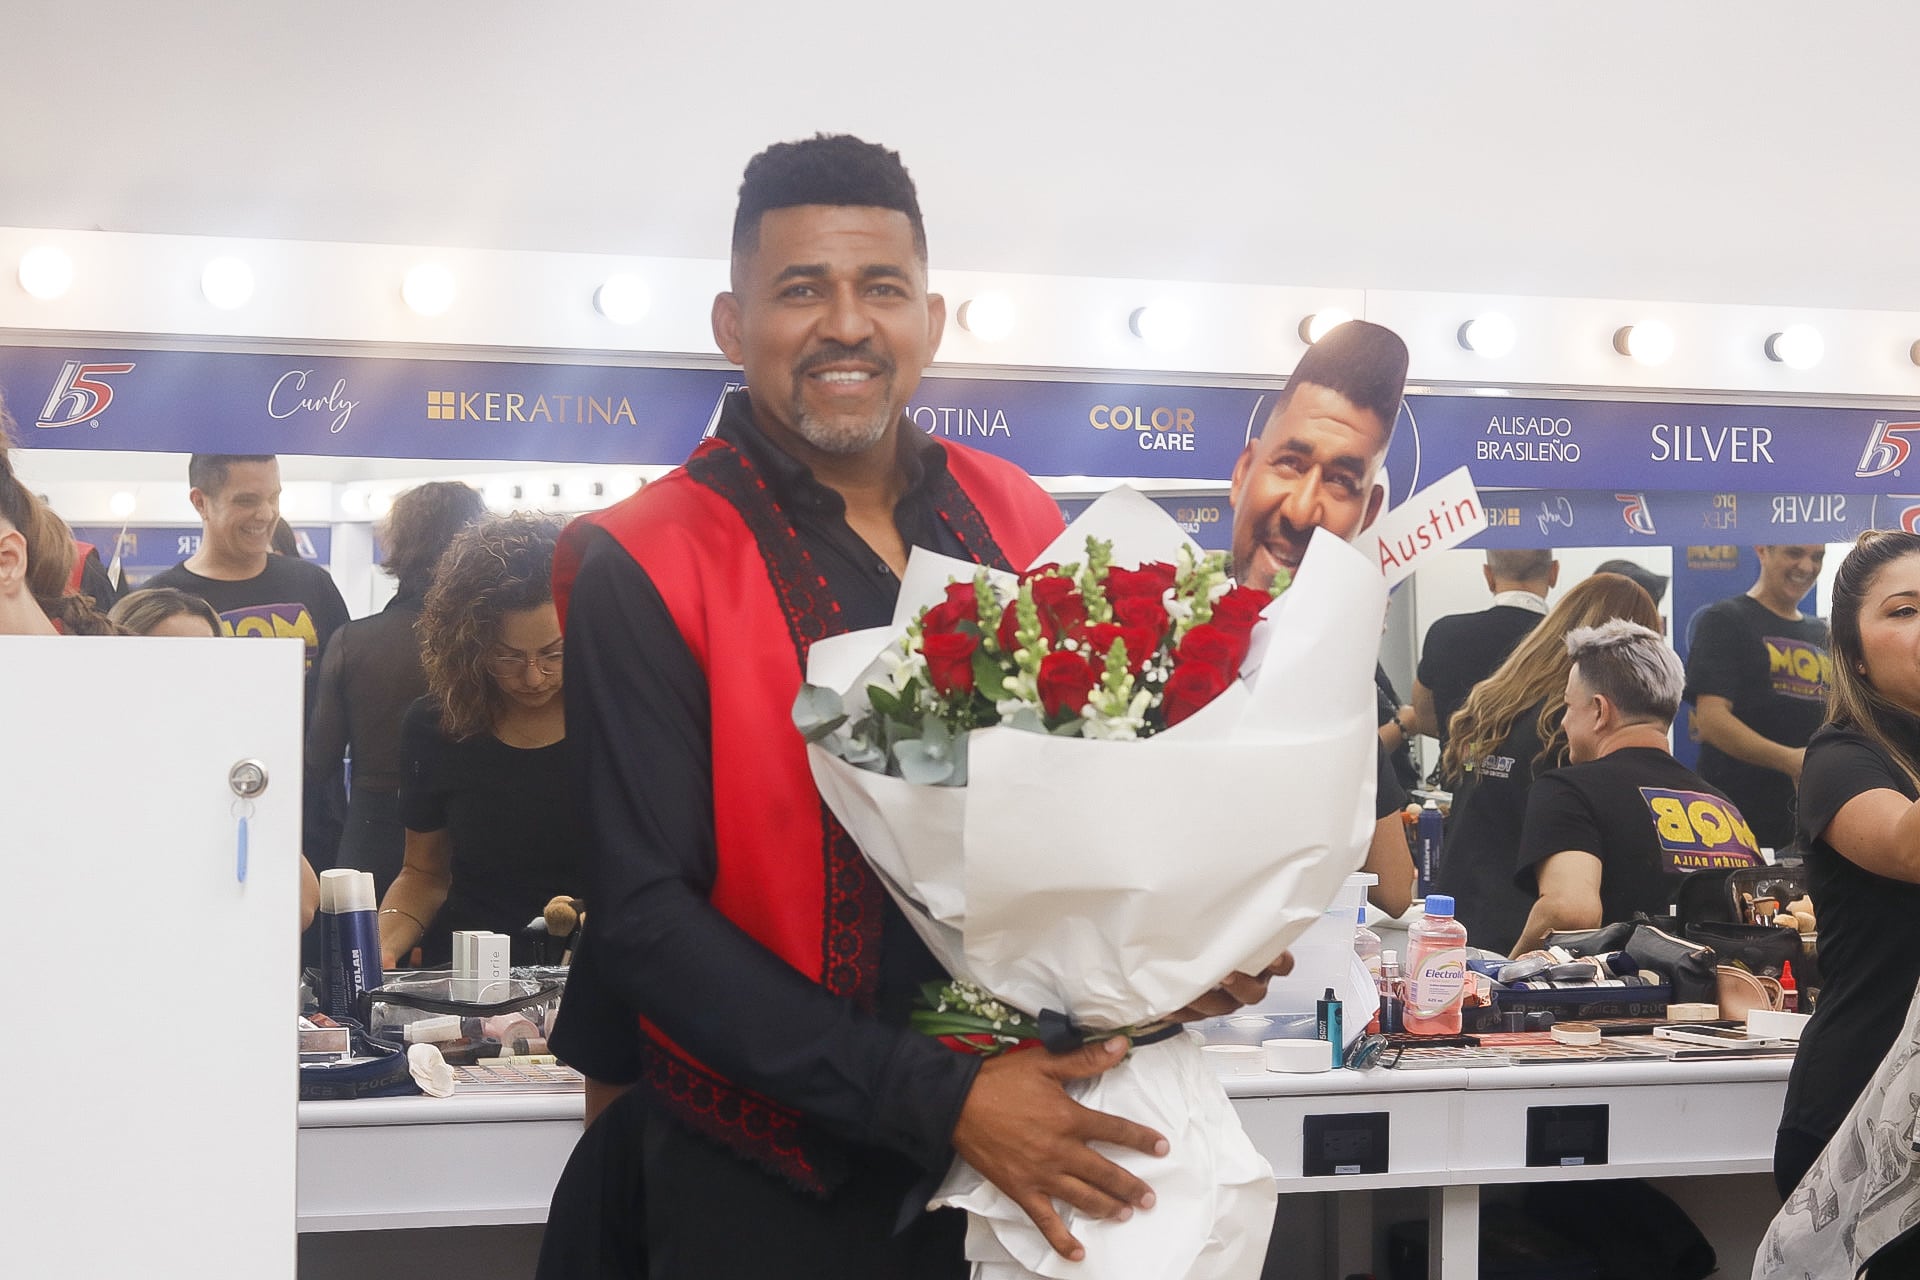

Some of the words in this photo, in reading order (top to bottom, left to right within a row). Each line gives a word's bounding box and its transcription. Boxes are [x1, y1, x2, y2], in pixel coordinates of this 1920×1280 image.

[266, 370, 359, 434] Curly
[462, 393, 637, 426] KERATINA
[1089, 404, 1195, 433] COLOR
[1138, 431, 1195, 451] CARE
[1486, 415, 1573, 438] ALISADO
[1476, 438, 1581, 464] BRASILEÑO
[1651, 424, 1774, 464] SILVER
[1377, 495, 1478, 577] Austin
[352, 949, 363, 999] YOLAN
